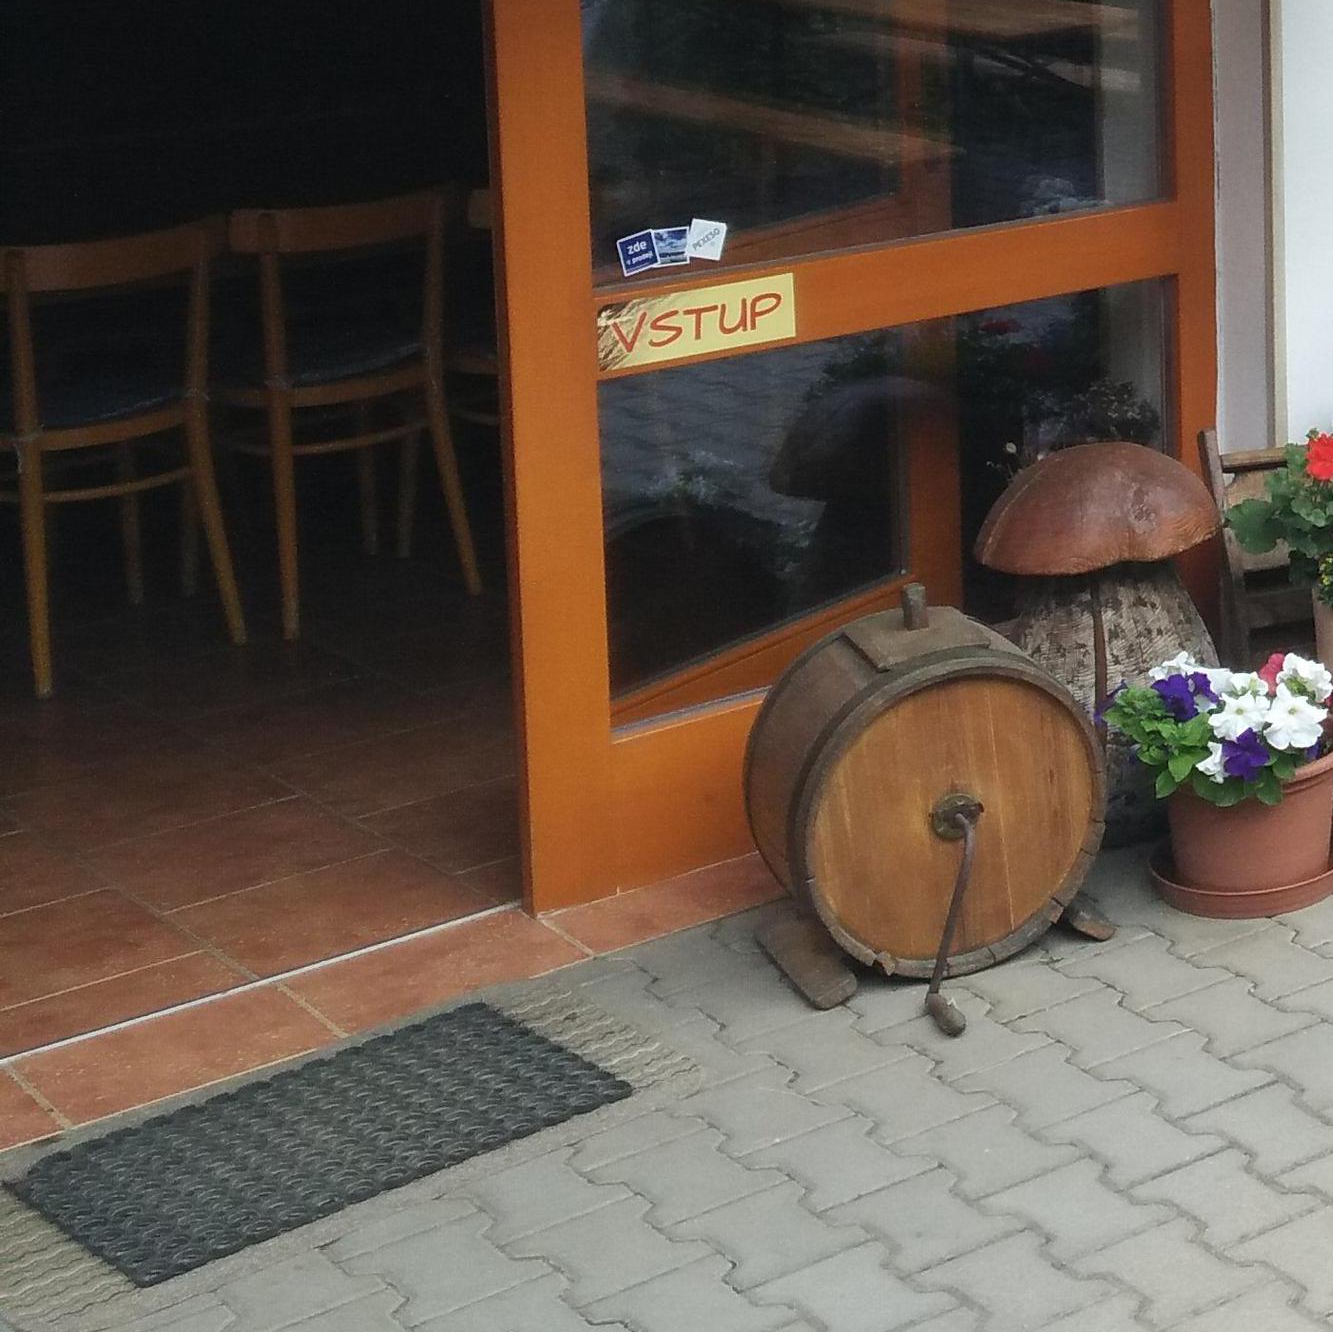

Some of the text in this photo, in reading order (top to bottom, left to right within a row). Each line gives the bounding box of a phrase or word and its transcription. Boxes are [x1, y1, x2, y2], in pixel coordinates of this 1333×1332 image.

[627, 241, 647, 255] zde
[692, 228, 720, 251] PEXESO
[611, 292, 782, 353] VSTUP
